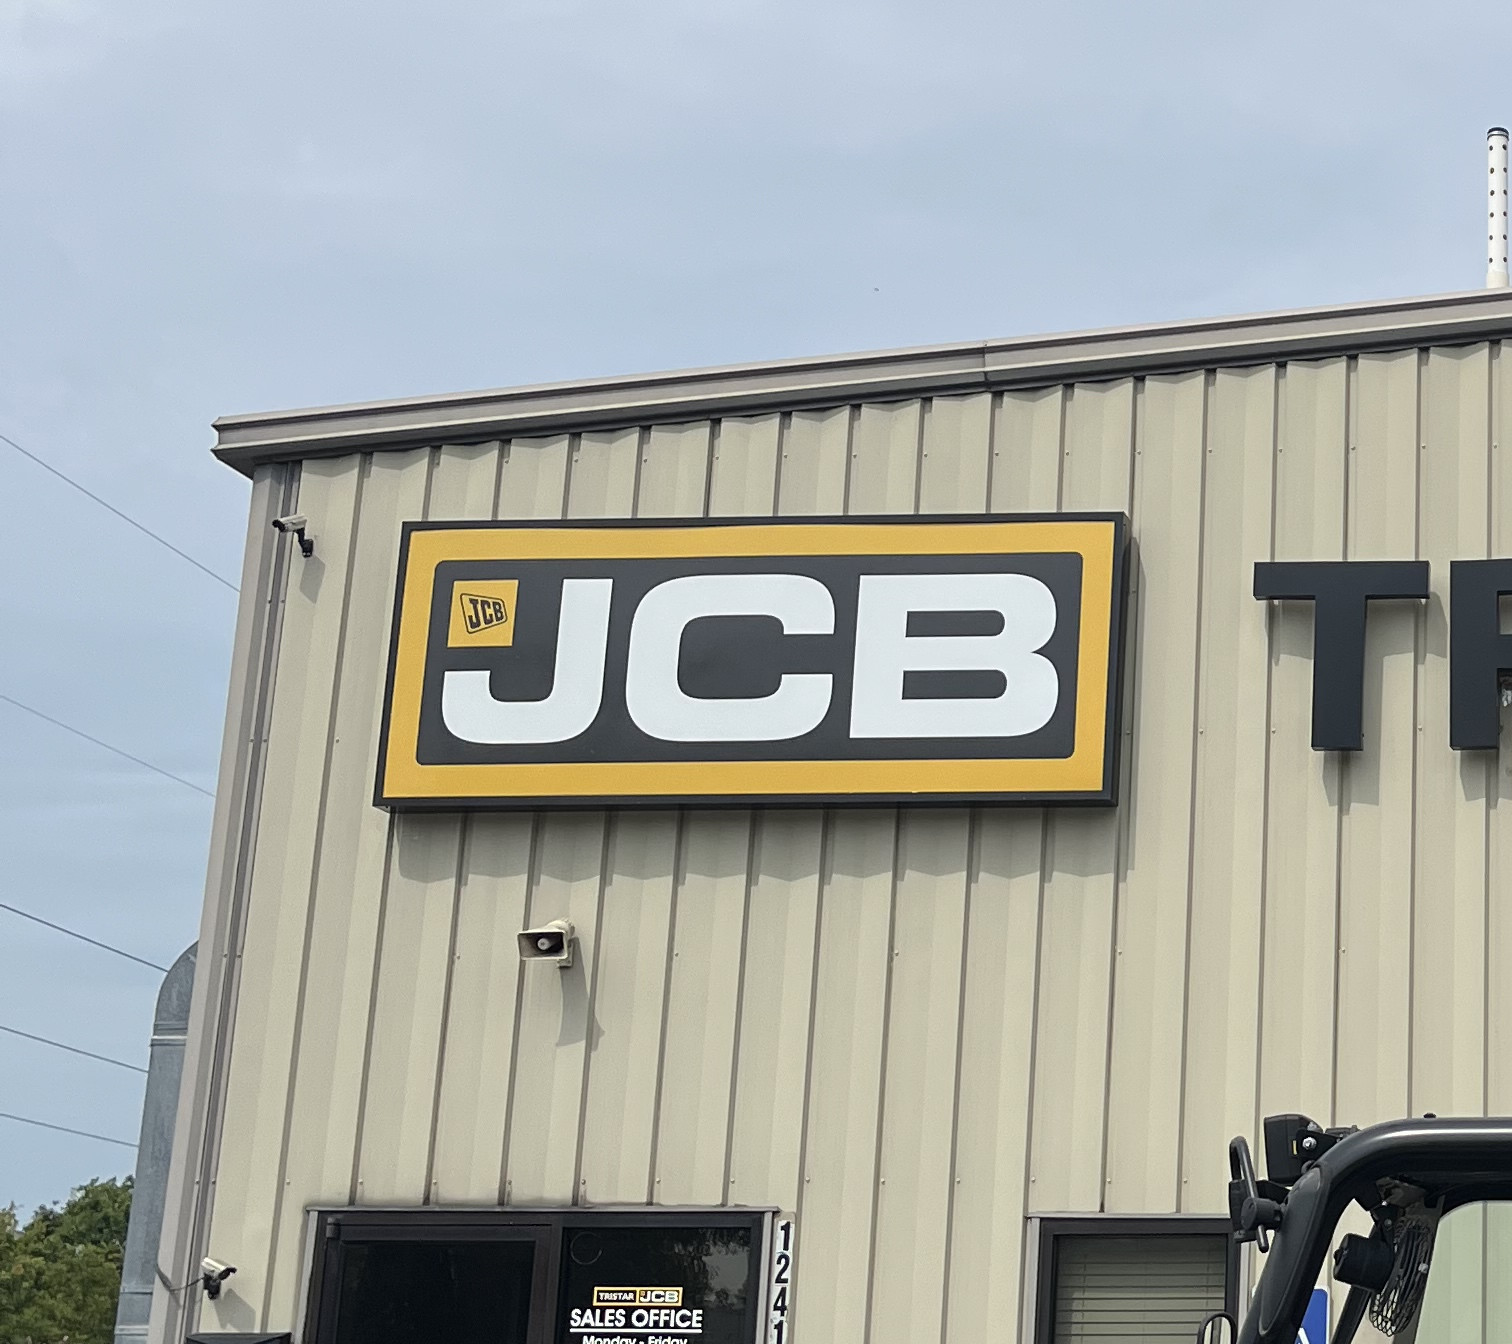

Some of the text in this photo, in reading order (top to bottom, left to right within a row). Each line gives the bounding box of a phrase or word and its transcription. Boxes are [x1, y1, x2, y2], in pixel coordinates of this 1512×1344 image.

[467, 597, 505, 630] JCB
[441, 573, 1059, 744] JCB
[598, 1290, 679, 1303] TRISTAR JCB
[569, 1308, 703, 1328] SALES OFFICE
